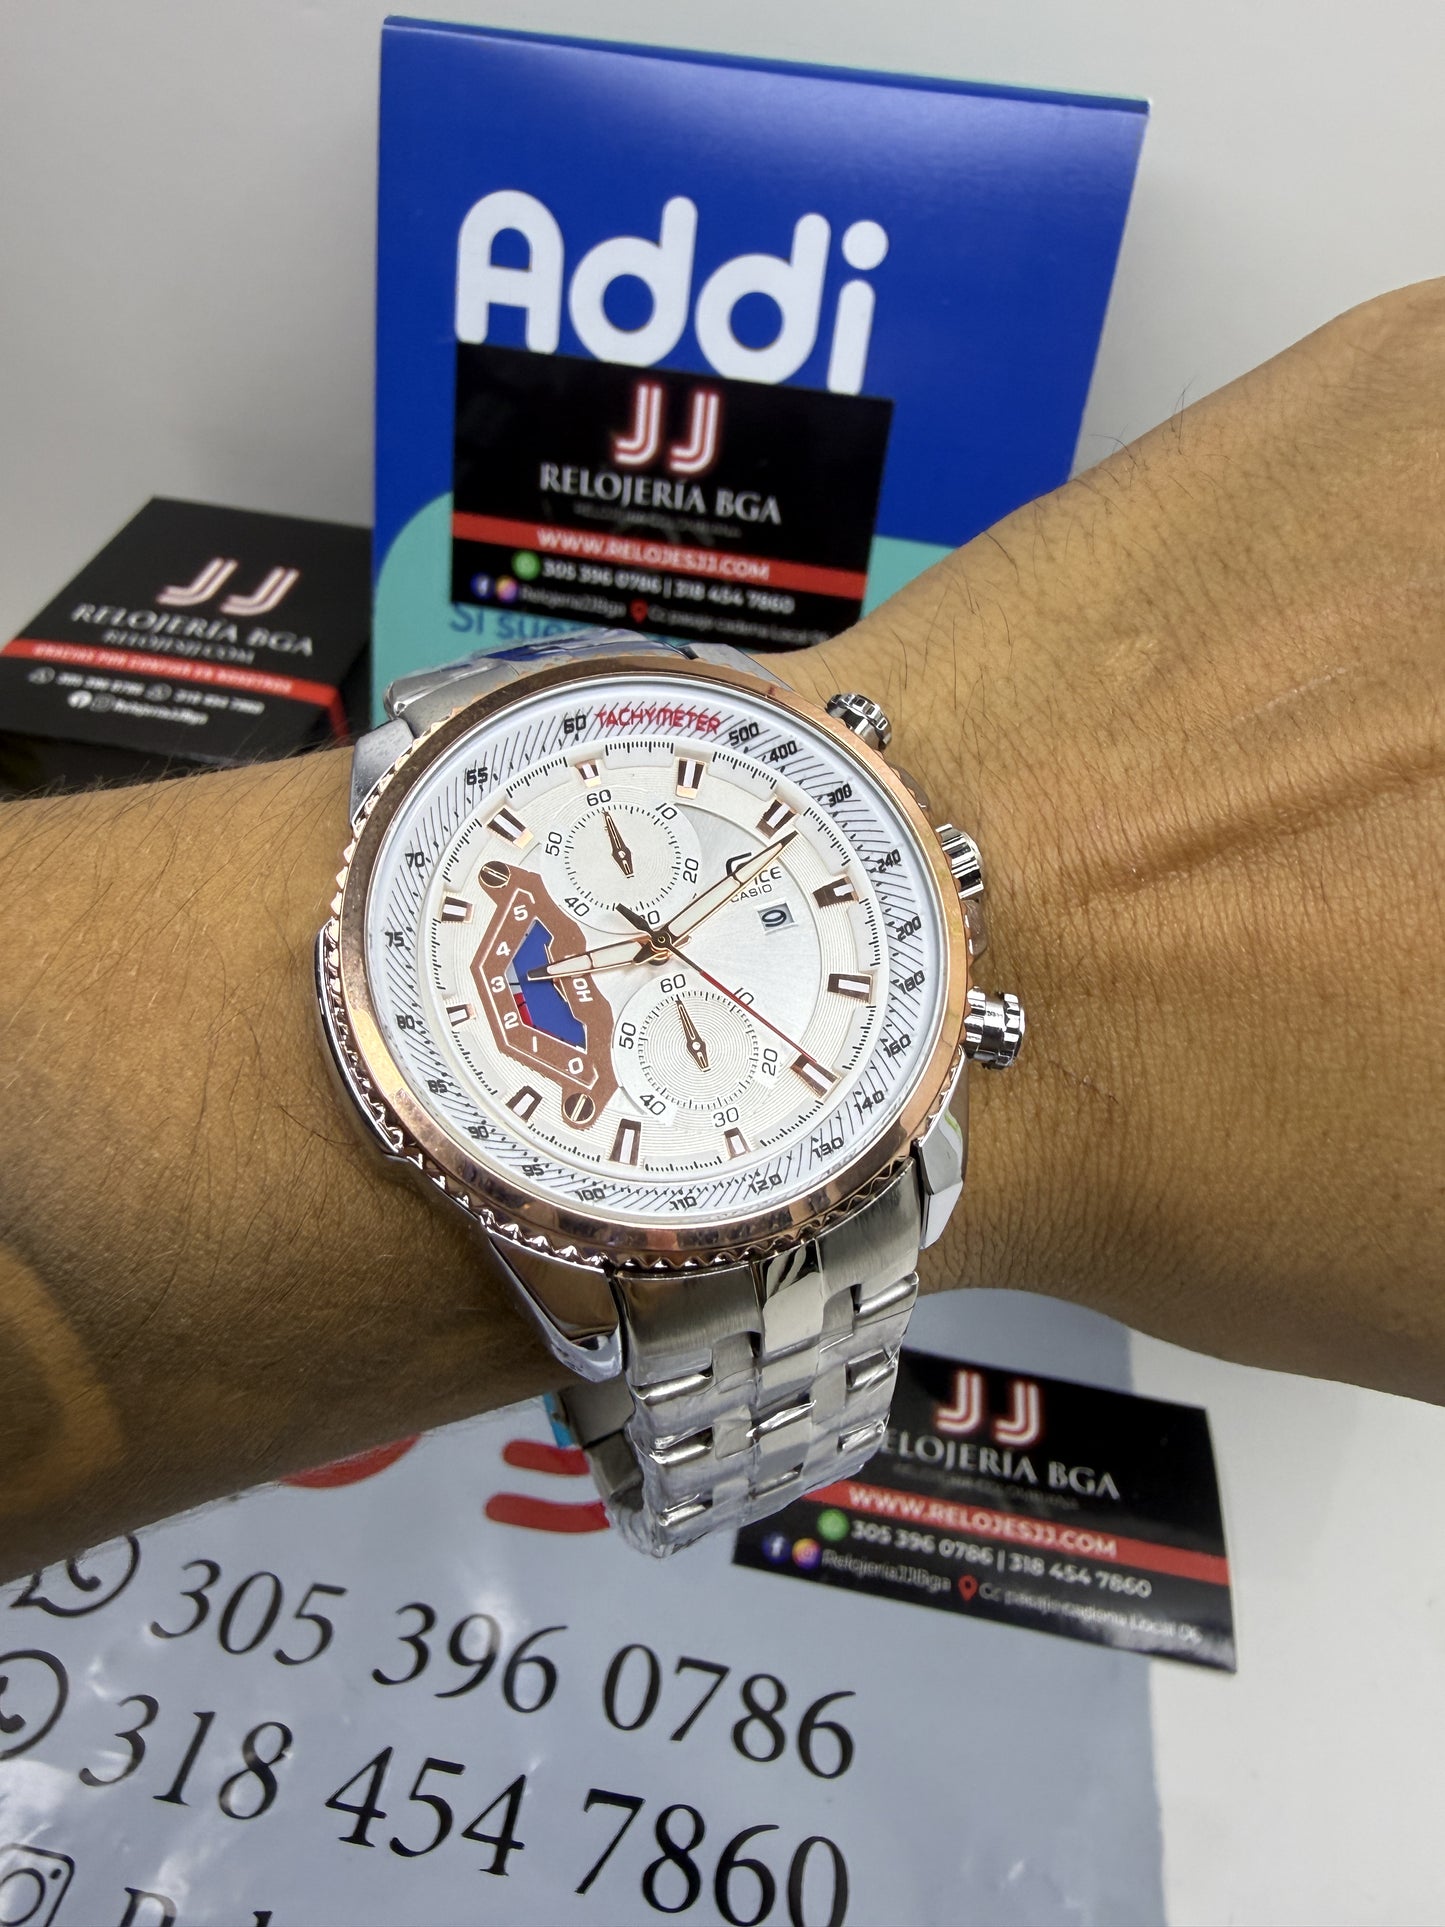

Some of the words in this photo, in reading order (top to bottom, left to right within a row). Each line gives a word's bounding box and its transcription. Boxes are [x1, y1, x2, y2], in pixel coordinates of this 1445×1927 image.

[455, 190, 889, 396] Addi
[715, 486, 782, 525] BGA
[246, 626, 314, 658] BGA
[564, 714, 587, 735] 60
[595, 706, 721, 735] TACHYMETER
[728, 721, 761, 747] 500
[769, 740, 798, 763] 400
[466, 766, 489, 786] 65
[586, 788, 612, 807] 60
[826, 782, 853, 808] 300
[655, 802, 678, 821] 10
[545, 831, 563, 857] 50
[405, 851, 425, 869] 70
[682, 857, 699, 884] 20
[877, 848, 902, 874] 240
[513, 904, 529, 922] 5
[564, 896, 590, 918] 40
[385, 931, 405, 948] 75
[895, 914, 923, 942] 200
[496, 940, 511, 957] 4
[491, 976, 506, 993] 3
[660, 973, 686, 994] 60
[899, 969, 926, 995] 180
[503, 1011, 520, 1030] 2
[618, 1021, 637, 1050] 50
[567, 1057, 585, 1075] 0
[761, 1047, 779, 1077] 20
[427, 1079, 449, 1094] 85
[639, 1093, 667, 1116] 40
[854, 1089, 885, 1115] 140
[712, 1106, 740, 1128] 30
[468, 1125, 489, 1140] 90
[521, 1163, 545, 1177] 95
[575, 1186, 606, 1202] 100
[750, 1172, 783, 1194] 120
[1048, 1460, 1121, 1501] BGA
[851, 1519, 892, 1545] 305
[895, 1528, 936, 1554] 396
[938, 1538, 994, 1566] 0786
[1008, 1553, 1045, 1577] 318
[1048, 1561, 1092, 1586] 454
[1095, 1570, 1153, 1599] 7860
[151, 1558, 347, 1667] 305
[371, 1602, 568, 1714] 396
[603, 1643, 857, 1780] 0786
[78, 1693, 294, 1821] 318
[324, 1745, 526, 1878] 454
[575, 1787, 850, 1927] 7860
